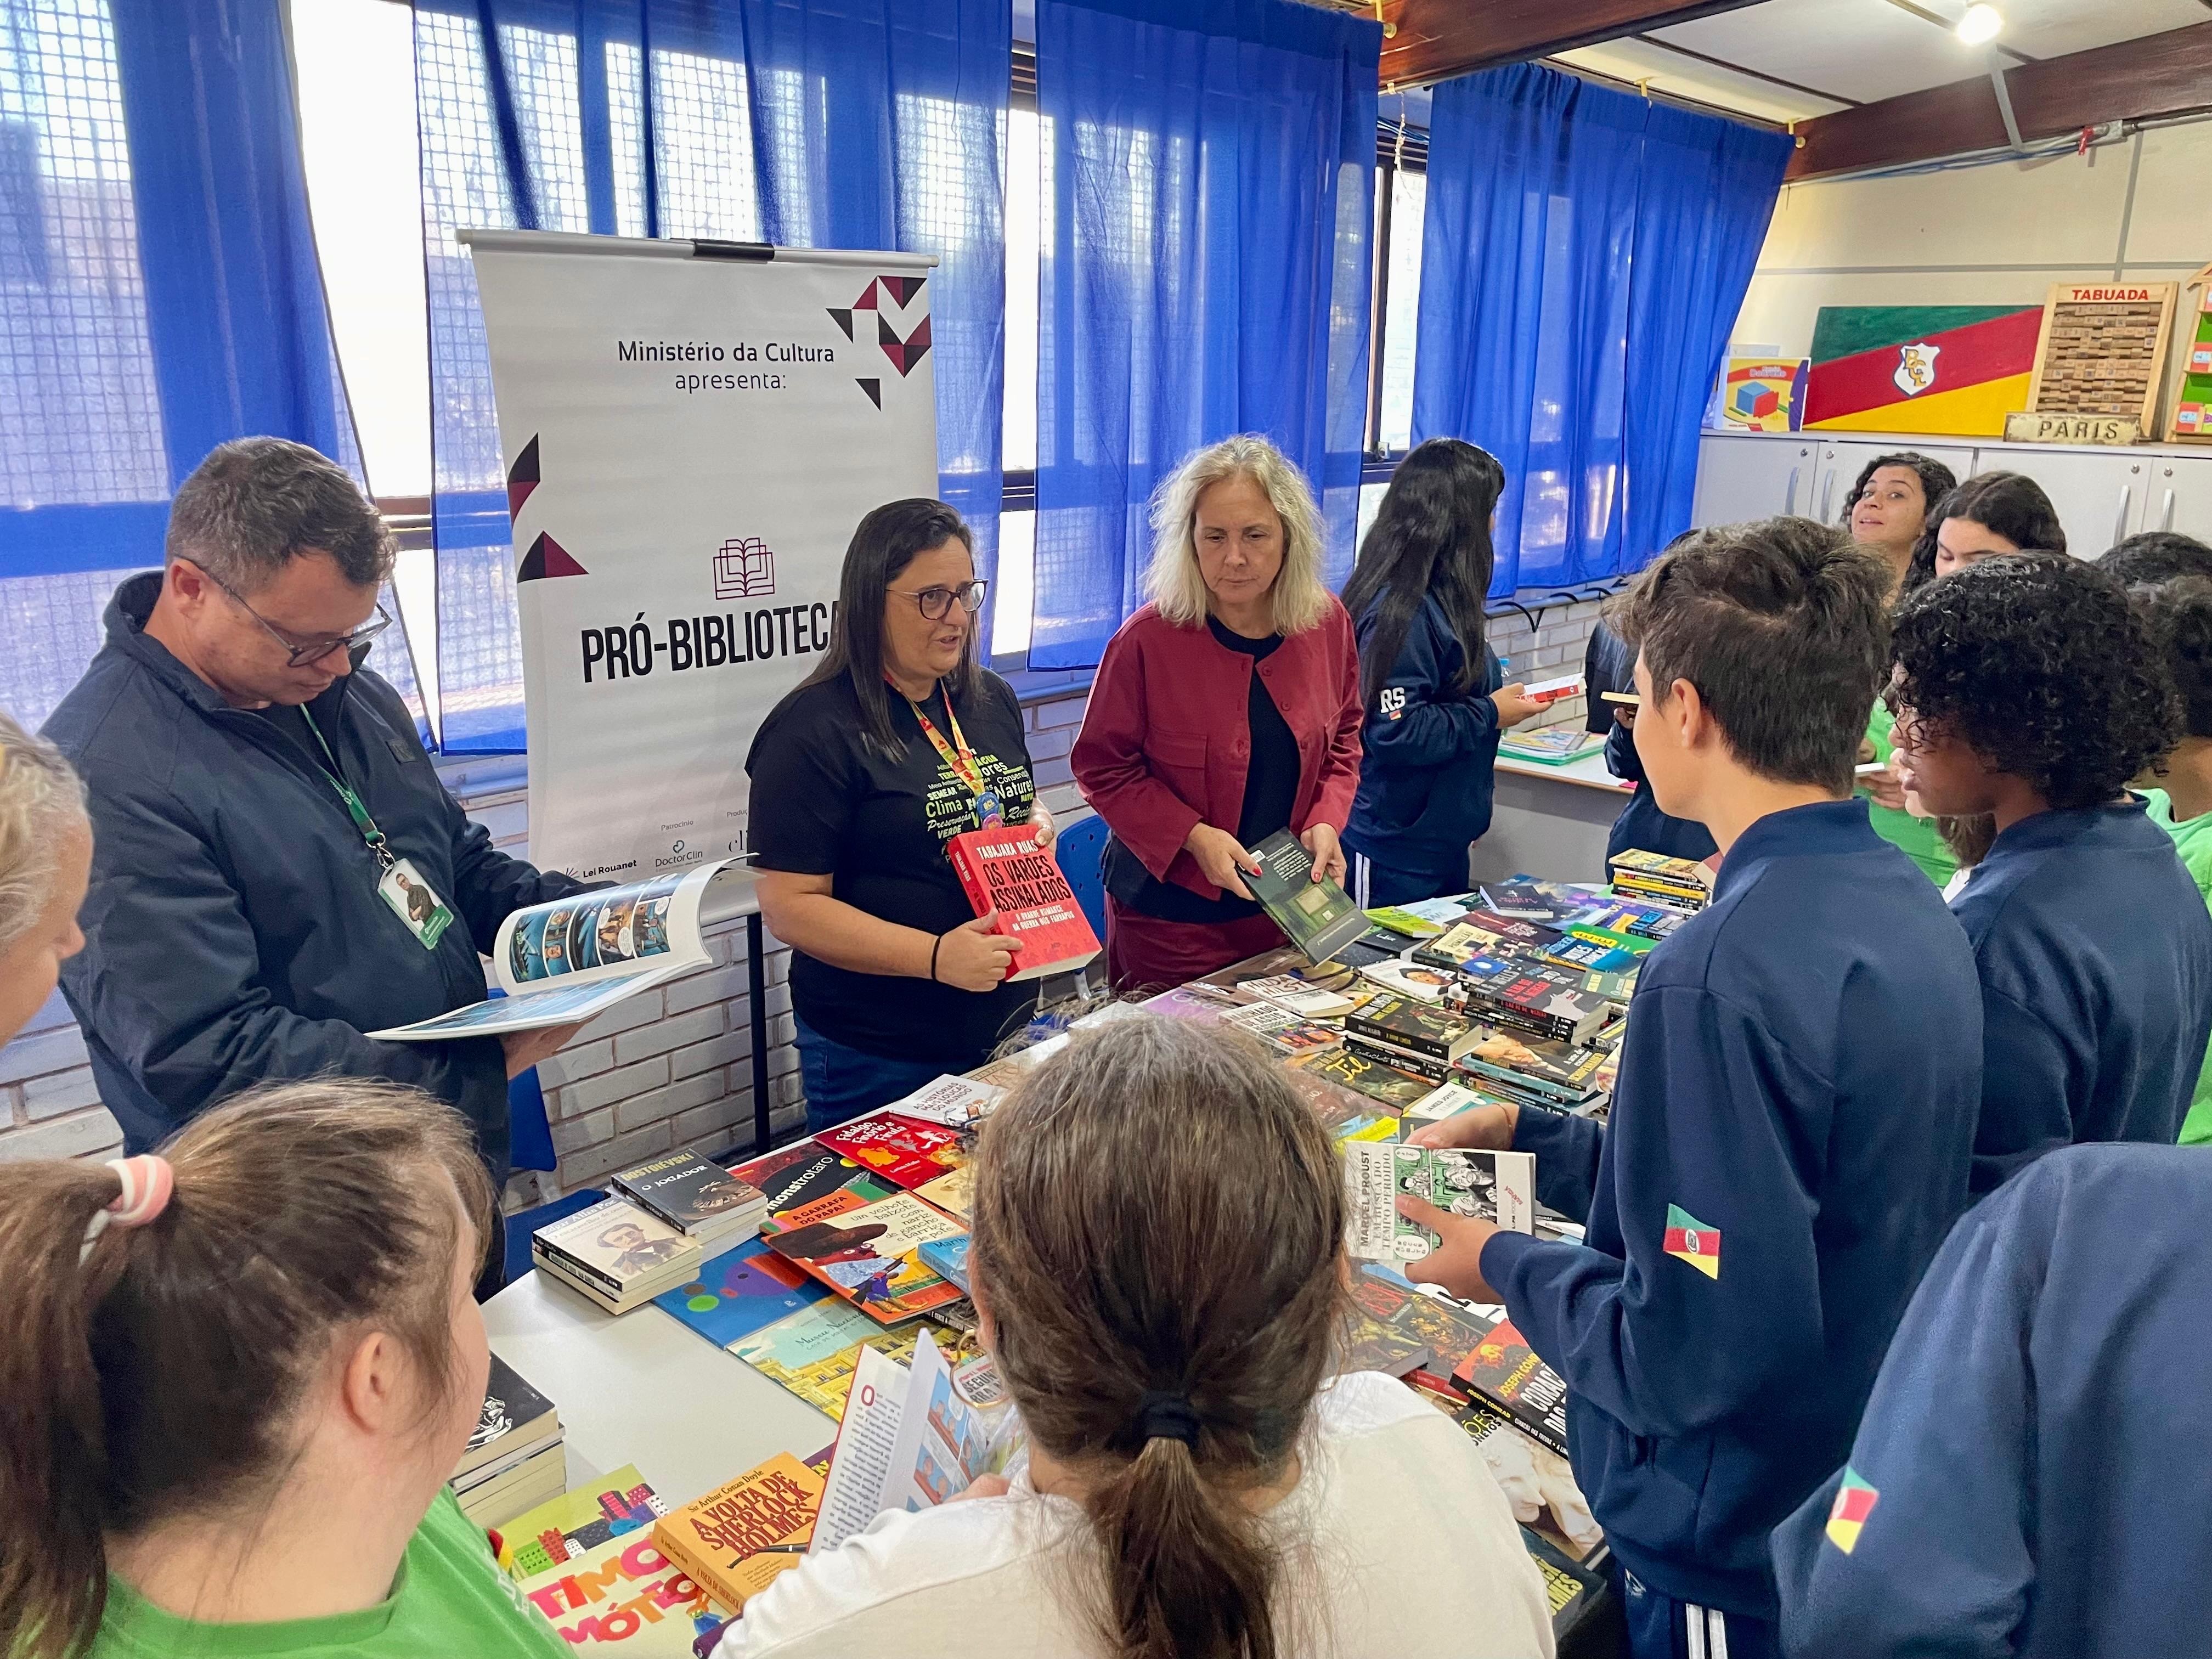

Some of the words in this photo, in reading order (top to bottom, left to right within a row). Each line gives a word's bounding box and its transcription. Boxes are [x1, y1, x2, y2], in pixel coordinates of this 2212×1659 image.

[2072, 289, 2149, 301] TABUADA
[618, 341, 724, 361] Ministério
[733, 342, 757, 361] da
[765, 343, 834, 362] Cultura
[675, 373, 786, 394] apresenta:
[2038, 420, 2118, 439] PARIS
[1380, 687, 1406, 713] RS
[927, 787, 957, 800] SEMEAR
[726, 809, 748, 818] Produç
[926, 799, 963, 817] Clima
[661, 820, 693, 831] Patrocínio
[937, 825, 962, 839] VERDE
[655, 850, 703, 867] DoctorClin
[976, 842, 1017, 860] TABAJARA
[1016, 839, 1039, 854] RUAS
[583, 870, 596, 878] Lei
[598, 860, 637, 874] Rouanet
[983, 862, 1005, 887] OS
[1003, 854, 1054, 884] VARÕES
[990, 877, 1071, 913] ASSINALADOS
[1020, 919, 1040, 929] GUERRA
[1039, 916, 1051, 925] DOS
[1050, 910, 1075, 923] FARRAPOS
[1246, 974, 1295, 989] HILDA
[1263, 981, 1307, 996] HILST
[1231, 1005, 1278, 1020] MACHADO
[1256, 1012, 1286, 1023] ASSIS
[1325, 1057, 1371, 1081] Til
[921, 1099, 941, 1111] MAIS
[939, 1084, 967, 1102] LOUCAS
[924, 1082, 959, 1104] HISTÓRIAS
[943, 1088, 973, 1107] MUNDO
[1426, 1101, 1443, 1112] JAMES
[1443, 1090, 1458, 1102] JOYCE
[836, 1121, 878, 1141] Fidalgo,
[851, 1124, 886, 1144] Finório
[874, 1125, 907, 1141] Firula
[620, 1152, 695, 1182] DOSTOIÉVSKI
[654, 1165, 708, 1187] JOGADOR
[1361, 1151, 1370, 1197] PROUST
[1373, 1161, 1382, 1178] DO
[768, 1156, 833, 1210] monstrotaro
[1382, 1153, 1391, 1206] PERDIDO
[800, 1196, 847, 1216] GARRAFA
[870, 1199, 910, 1215] velhote
[1373, 1182, 1383, 1220] BUSCA
[539, 1220, 569, 1234] Edgar
[572, 1208, 597, 1222] Allan
[597, 1200, 617, 1211] Poe
[799, 1216, 815, 1224] DO
[815, 1205, 845, 1219] PAPAI
[874, 1204, 917, 1220] baixote
[901, 1209, 924, 1218] com
[902, 1212, 932, 1226] nariz
[900, 1217, 939, 1234] gancho
[905, 1222, 947, 1239] barriga
[929, 1227, 953, 1239] pote
[1382, 1209, 1391, 1249] TEMPO
[934, 1237, 967, 1249] Marth
[795, 1330, 830, 1347] Museu
[962, 1370, 997, 1392] SEGUN
[1498, 1369, 1522, 1397] JOSEPH
[861, 1384, 875, 1406] O
[1466, 1389, 1486, 1404] JOSEPH
[1487, 1401, 1511, 1418] CONRAD
[1462, 1409, 1495, 1435] ÕES
[687, 1505, 699, 1513] Sir
[698, 1492, 723, 1508] Arthur
[721, 1480, 744, 1494] Conan
[742, 1469, 764, 1484] Doyle
[690, 1518, 712, 1535] A
[702, 1487, 768, 1523] VOLTA
[759, 1470, 794, 1494] DE
[700, 1481, 814, 1551] SHERLOCK
[730, 1498, 819, 1560] HOLMES
[700, 1570, 712, 1587] VOLTA
[712, 1581, 719, 1592] DE
[718, 1583, 740, 1609] SHERLOCK
